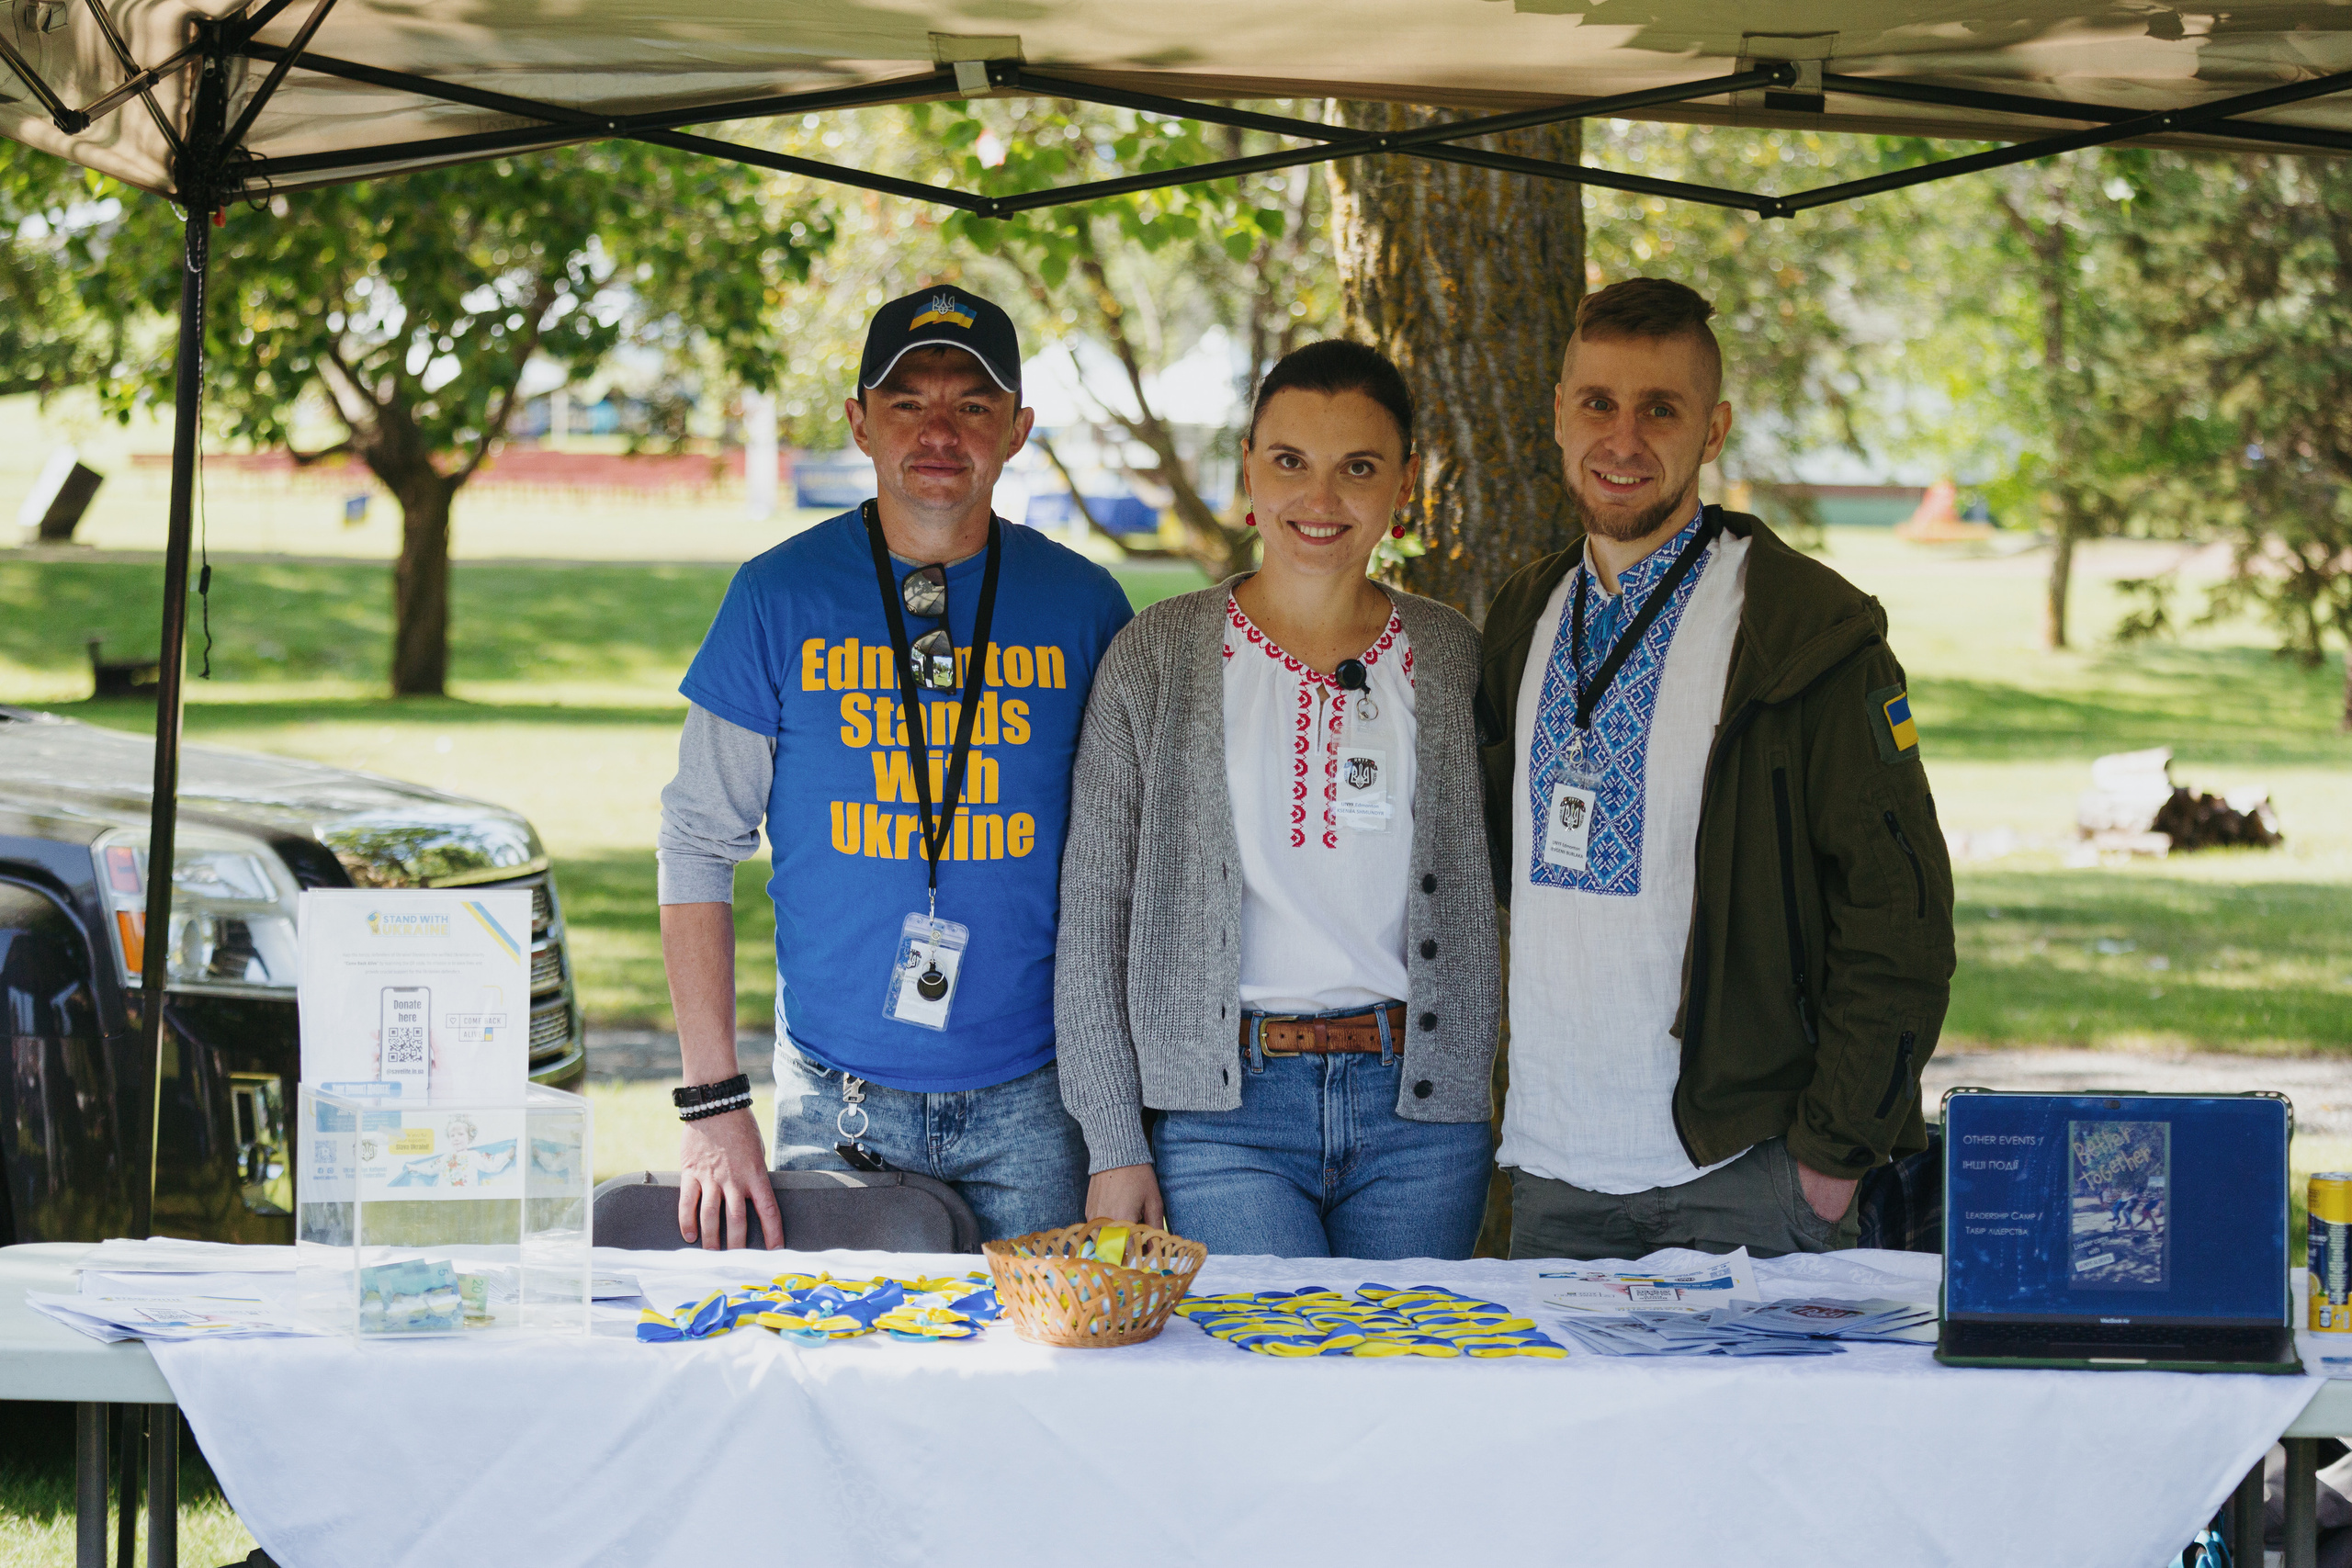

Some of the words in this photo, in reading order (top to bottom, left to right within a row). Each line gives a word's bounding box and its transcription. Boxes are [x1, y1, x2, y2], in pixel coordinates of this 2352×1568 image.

[801, 637, 1067, 692] Edmnton
[840, 691, 1031, 748] Stands
[871, 750, 999, 804] Wih
[1562, 842, 1580, 851] Edmonton
[383, 915, 417, 923] STAND
[420, 915, 448, 923] WITH
[382, 924, 448, 935] UKRAINE
[393, 999, 422, 1010] Donate
[398, 1012, 417, 1022] here
[1962, 1136, 1996, 1145] OTHER
[1999, 1136, 2035, 1145] EVENTS
[437, 1269, 449, 1277] 5
[471, 1279, 484, 1293] 20
